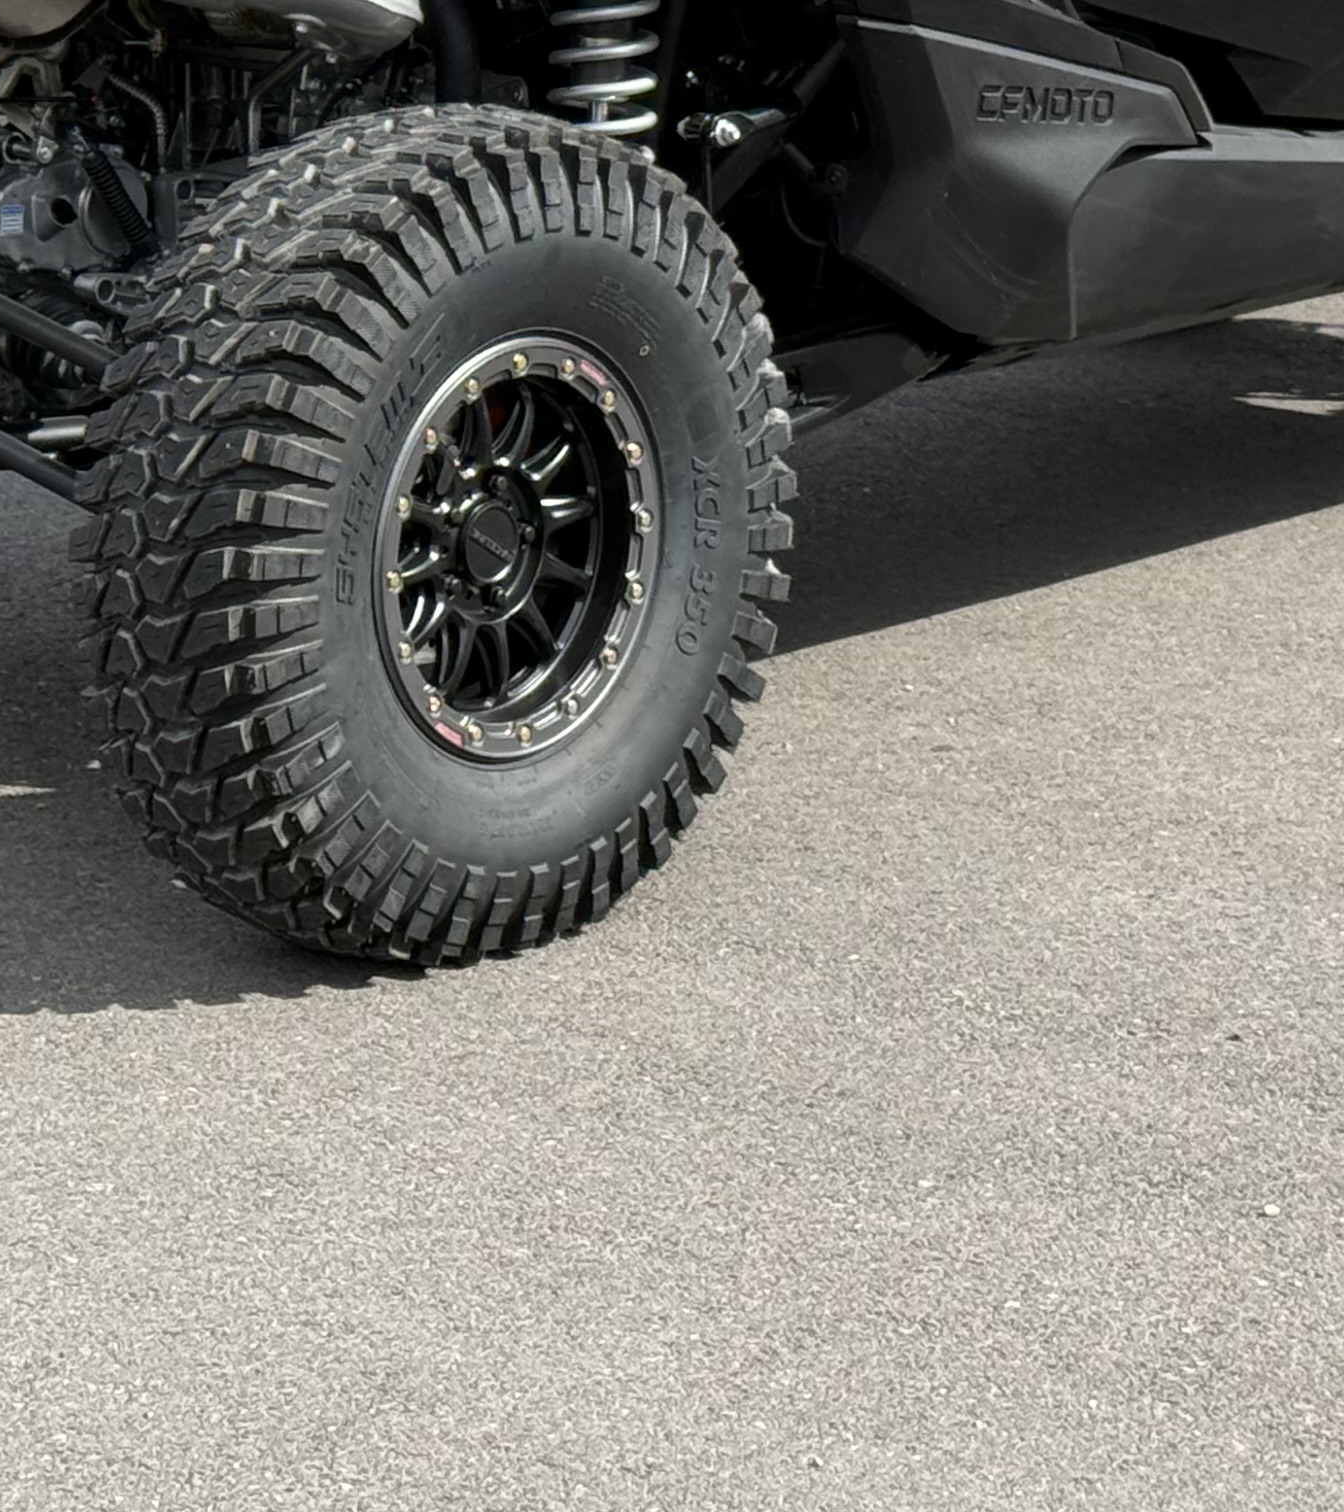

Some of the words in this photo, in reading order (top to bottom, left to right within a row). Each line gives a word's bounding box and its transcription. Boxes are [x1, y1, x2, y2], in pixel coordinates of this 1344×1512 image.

[975, 84, 1114, 127] CFMOTO
[690, 455, 722, 549] XCR
[674, 562, 717, 656] 350
